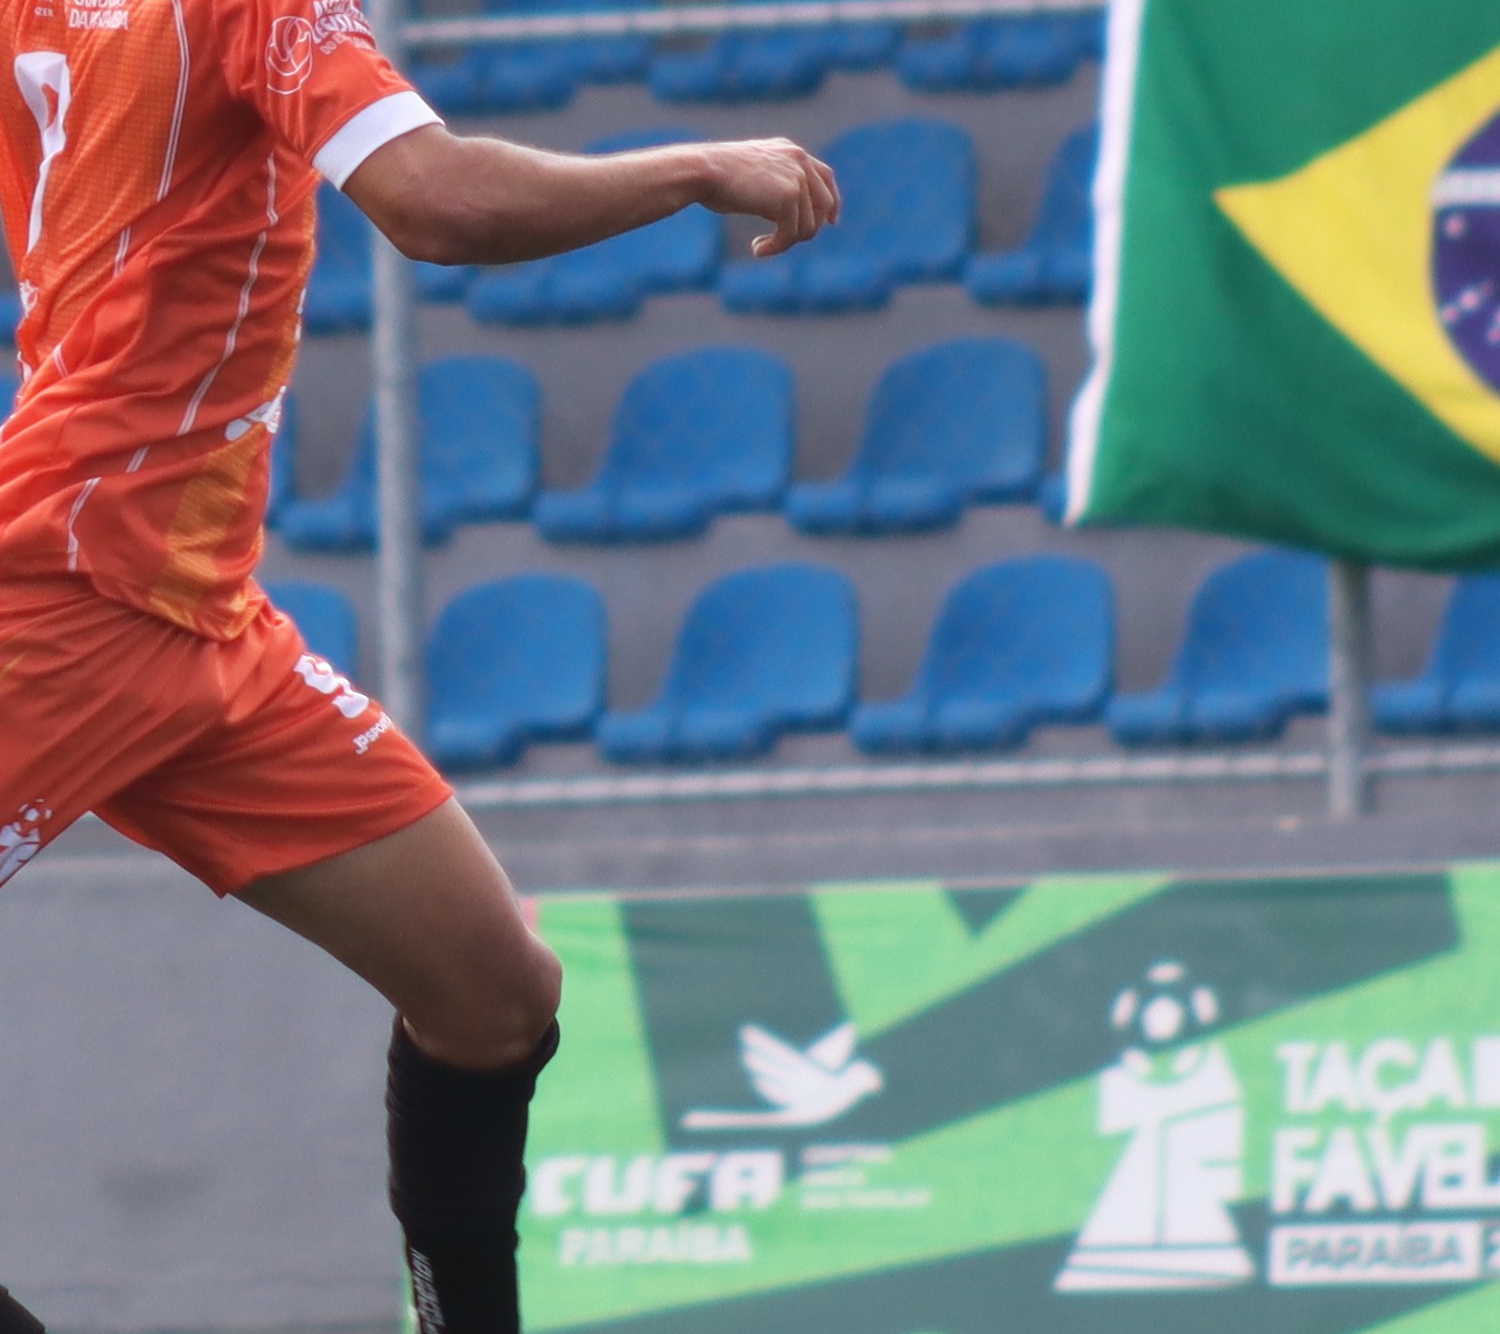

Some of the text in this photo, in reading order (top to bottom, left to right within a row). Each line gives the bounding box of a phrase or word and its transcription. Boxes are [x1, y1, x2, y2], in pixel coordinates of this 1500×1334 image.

[1274, 1036, 1469, 1114] TAÇA
[530, 1150, 784, 1217] CUFA
[558, 1220, 752, 1267] PARAÍBA
